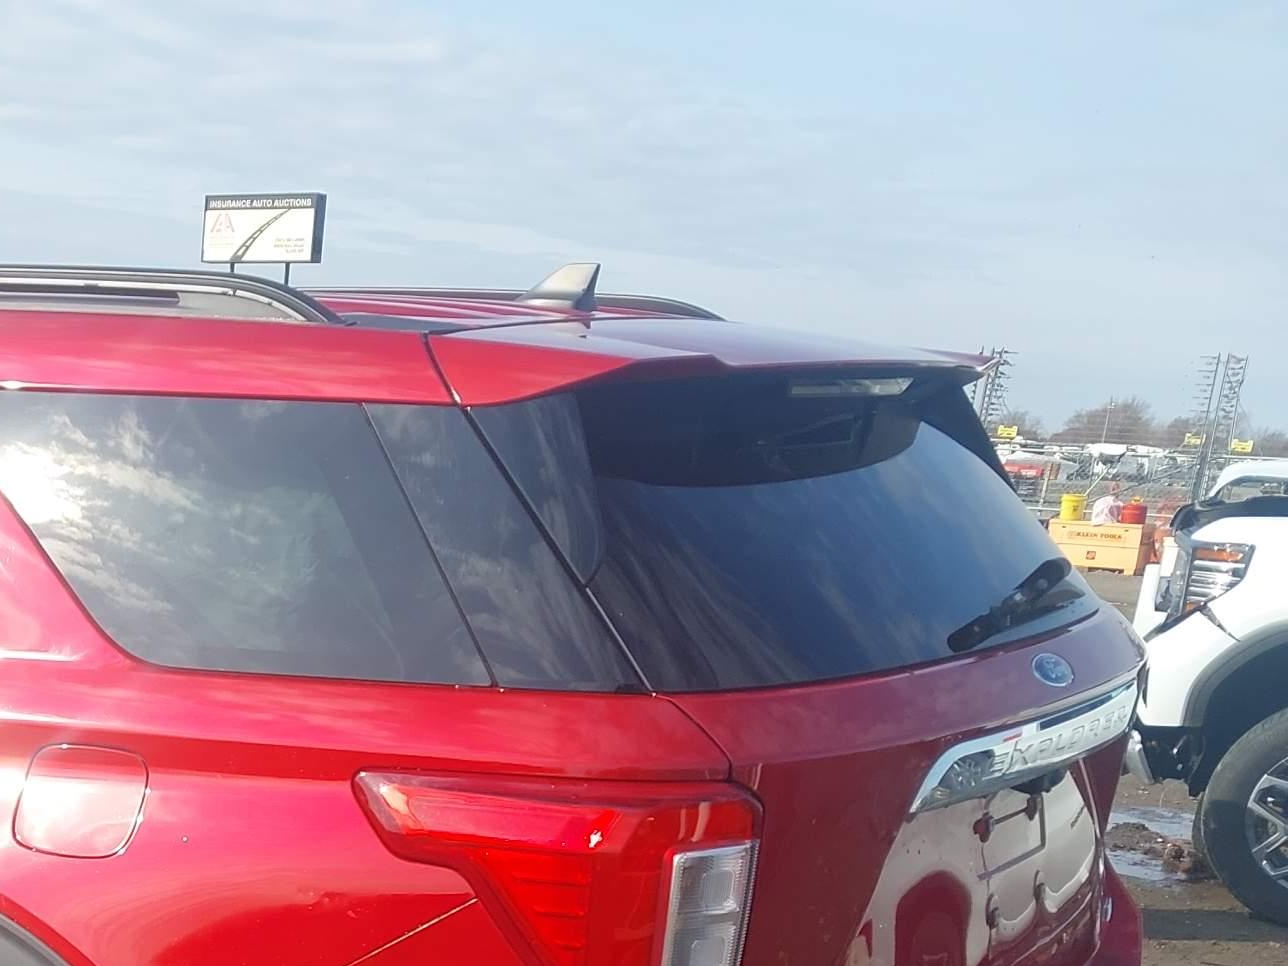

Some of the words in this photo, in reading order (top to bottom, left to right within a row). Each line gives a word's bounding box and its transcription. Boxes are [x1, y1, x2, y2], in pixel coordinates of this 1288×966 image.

[209, 199, 251, 208] INSURANCE
[252, 199, 273, 208] AUTO
[274, 198, 312, 207] AUCTIONS
[988, 705, 1128, 774] EXPLORER
